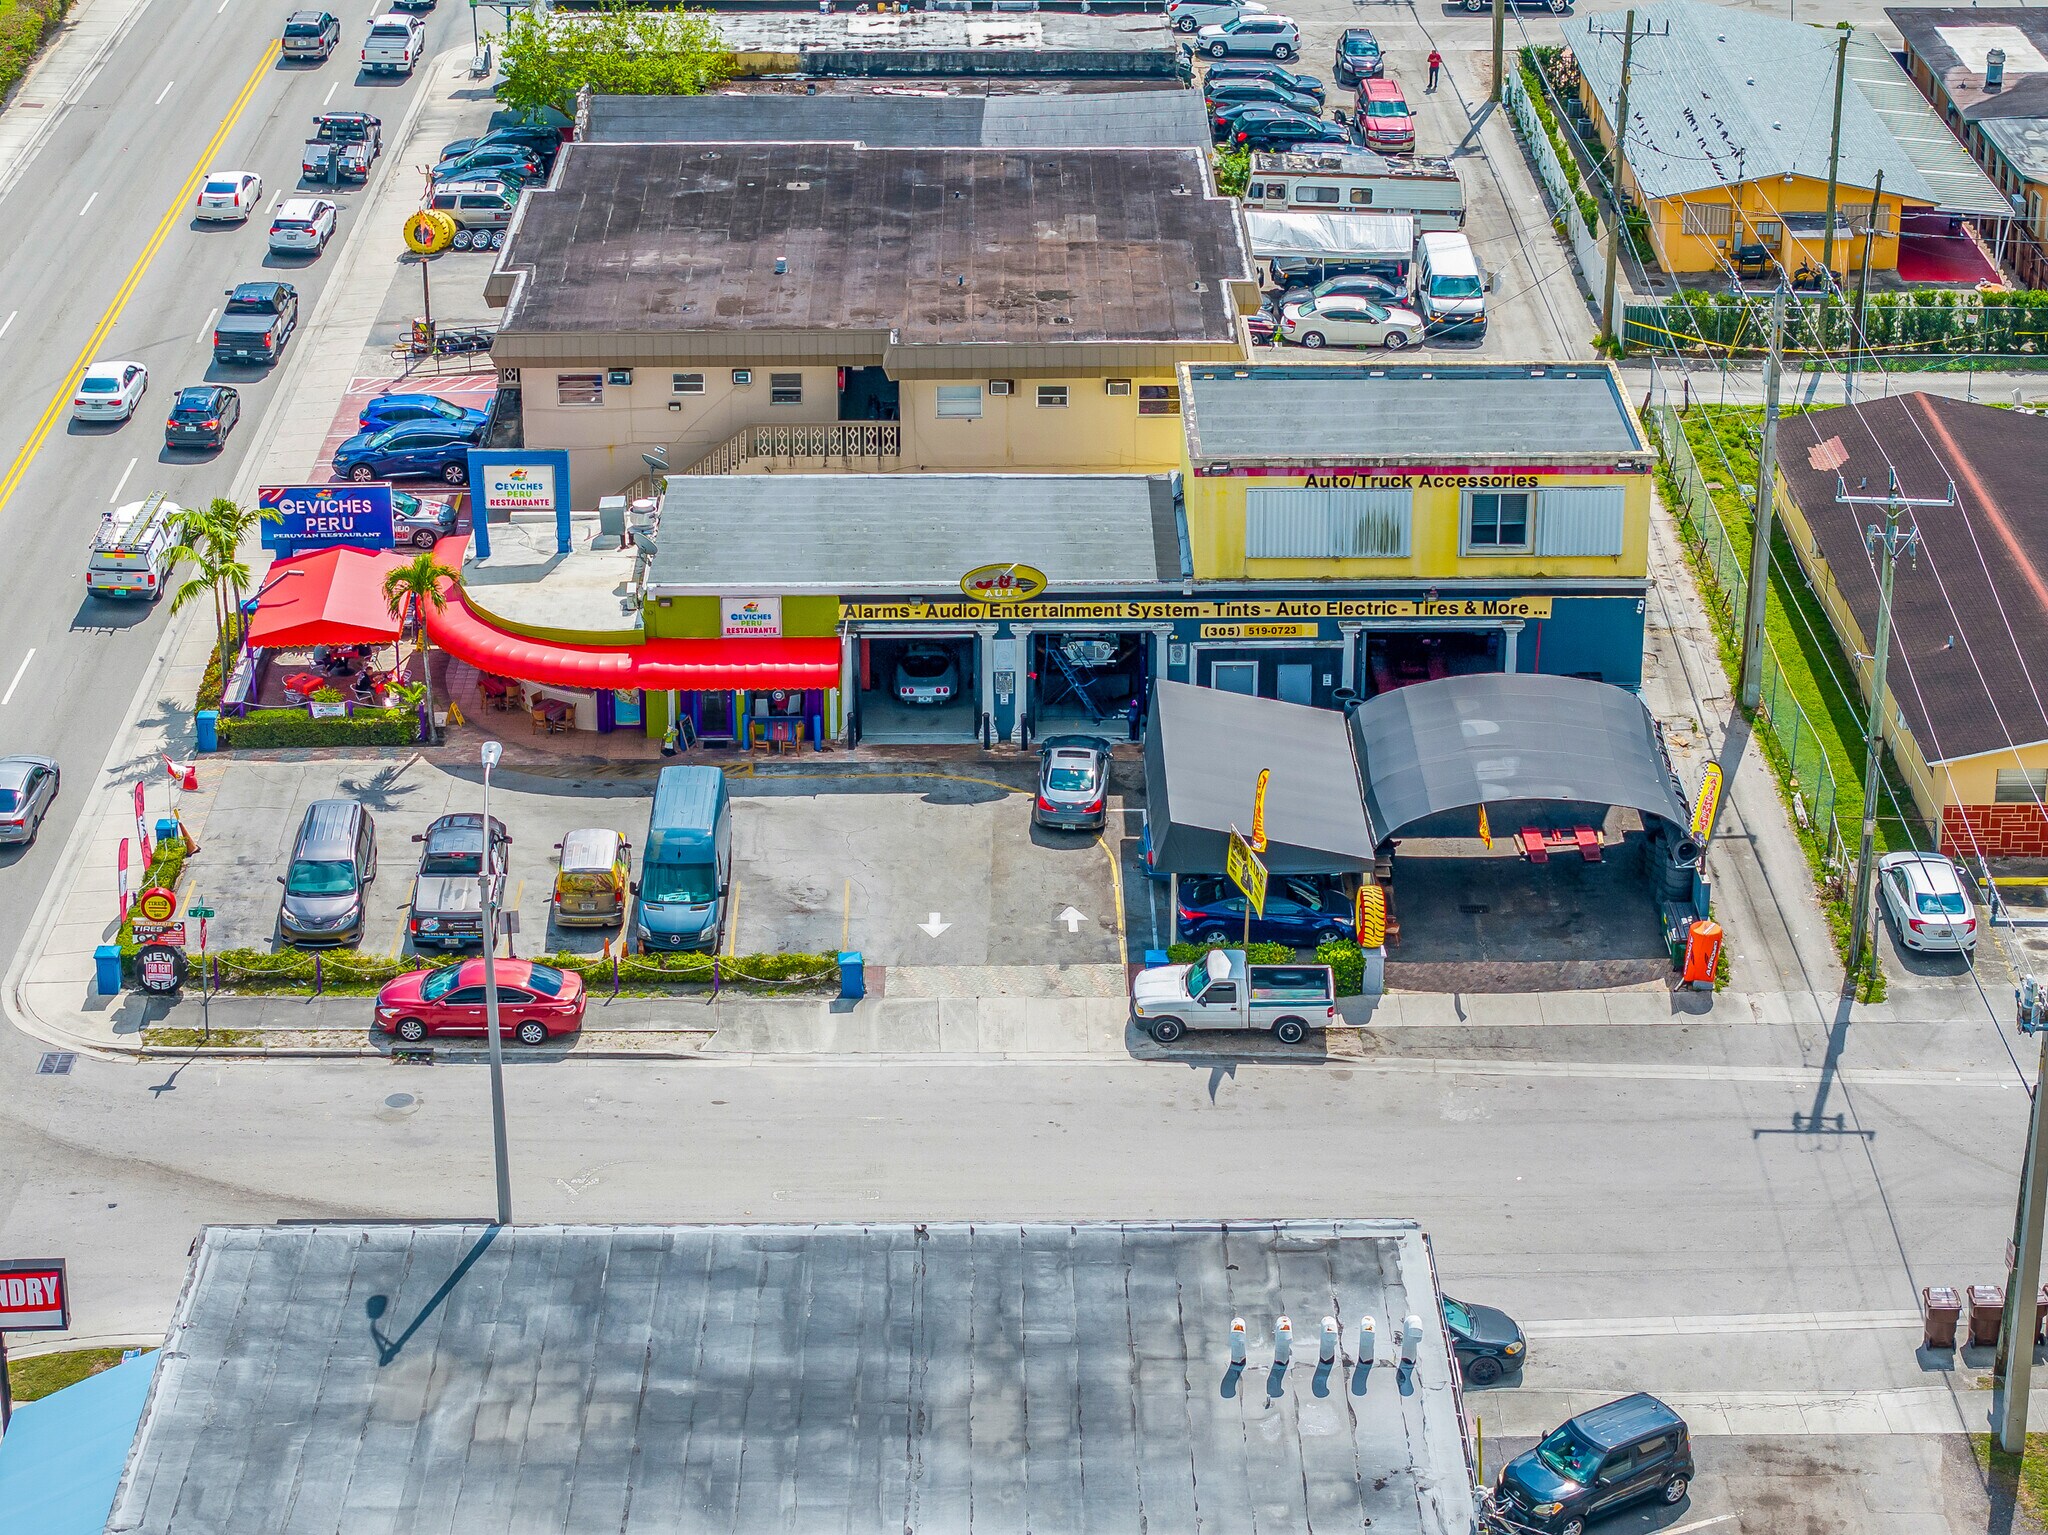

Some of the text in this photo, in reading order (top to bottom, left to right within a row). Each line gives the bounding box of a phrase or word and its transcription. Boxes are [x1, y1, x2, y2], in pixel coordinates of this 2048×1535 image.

[495, 482, 543, 490] CEVICHES
[1304, 472, 1539, 489] Auto/Truck Accessories
[507, 490, 532, 498] PERU
[278, 499, 372, 515] CEVICHES
[305, 517, 354, 531] PERU
[843, 603, 910, 618] Alarms
[925, 602, 1122, 619] Audio/Entertainment
[1127, 602, 1199, 619] System
[1213, 602, 1261, 617] Tints
[1277, 602, 1321, 616] Auto
[1327, 601, 1398, 616] Electric
[1412, 601, 1460, 616] Tires
[1464, 601, 1477, 615] &
[1482, 601, 1529, 615] More
[1204, 626, 1241, 637] (305)
[1248, 626, 1297, 635] 519-0723
[143, 952, 175, 965] NEW
[148, 963, 171, 974] FOR RENT
[142, 974, 178, 990] USED
